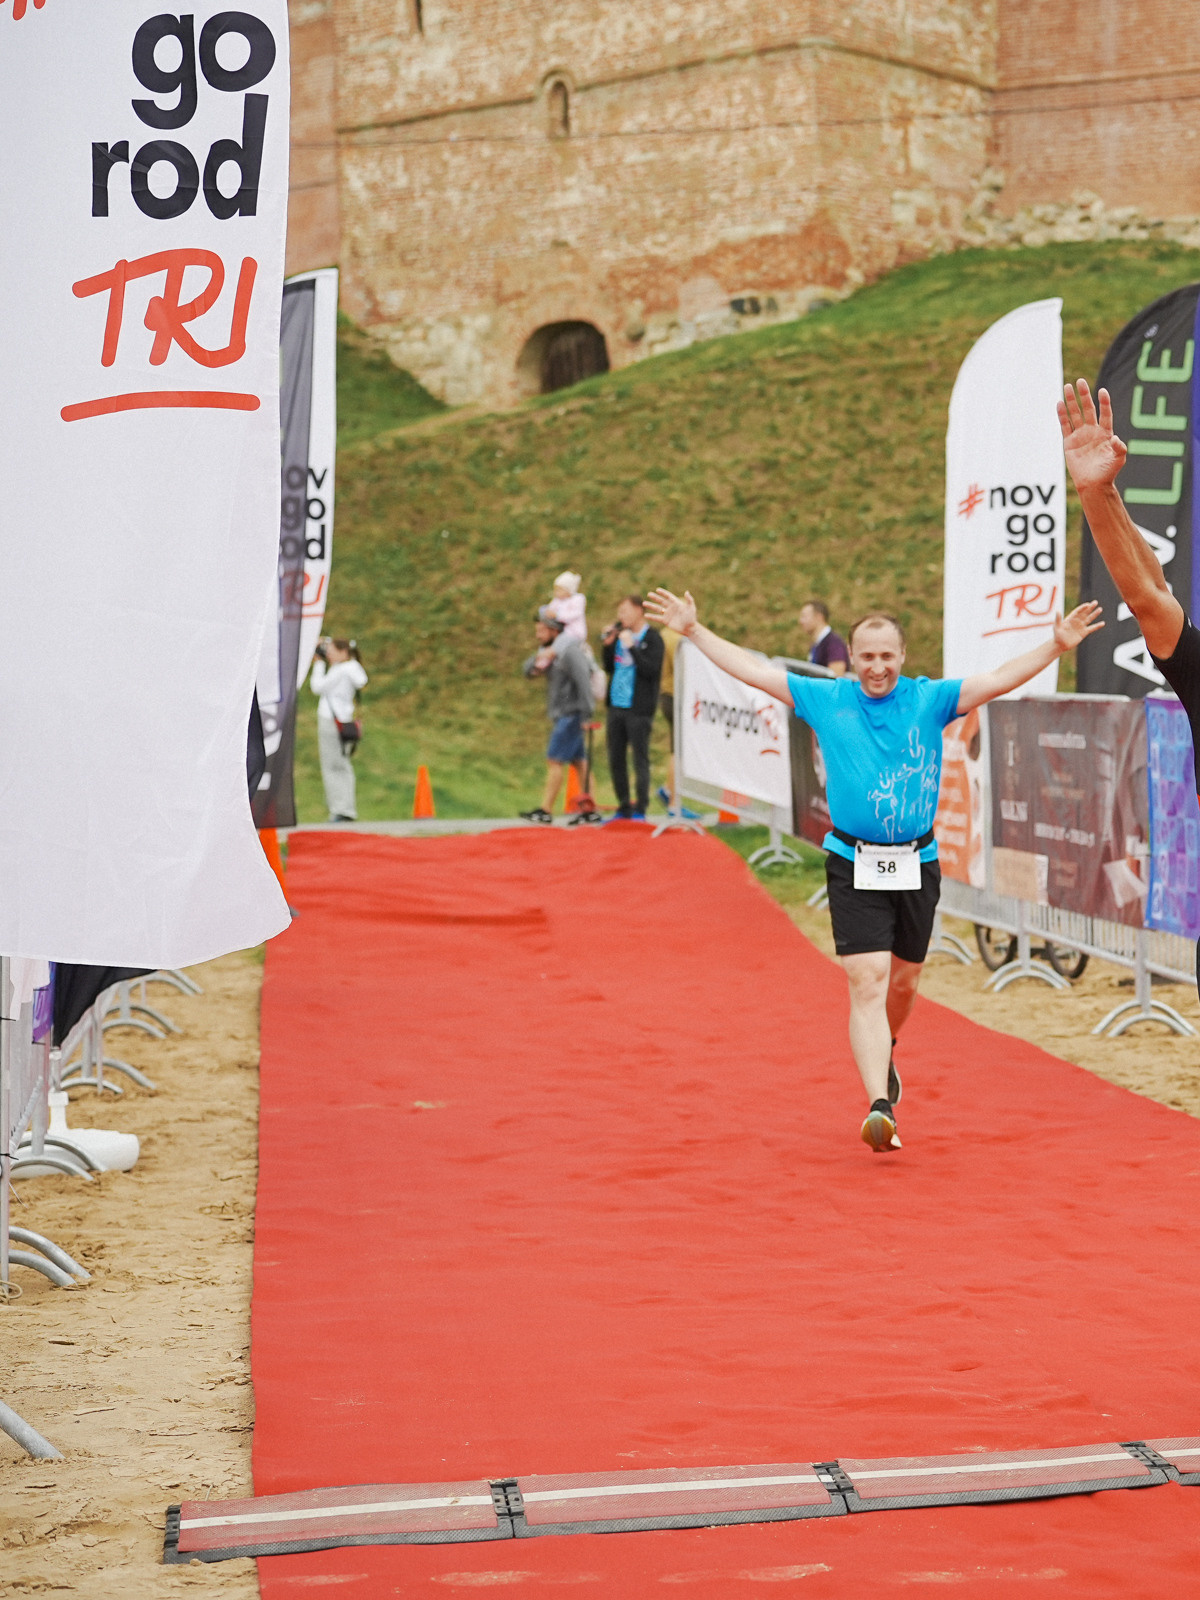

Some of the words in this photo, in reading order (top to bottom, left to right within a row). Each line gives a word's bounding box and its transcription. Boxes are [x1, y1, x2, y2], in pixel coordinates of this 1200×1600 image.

[132, 11, 276, 130] go
[91, 93, 269, 220] rod
[72, 248, 258, 368] TRI
[1124, 338, 1195, 505] LIFE
[958, 483, 1056, 519] #nov
[1006, 513, 1056, 546] go
[990, 538, 1056, 574] rod
[986, 584, 1057, 618] TRI
[877, 861, 897, 874] 58
